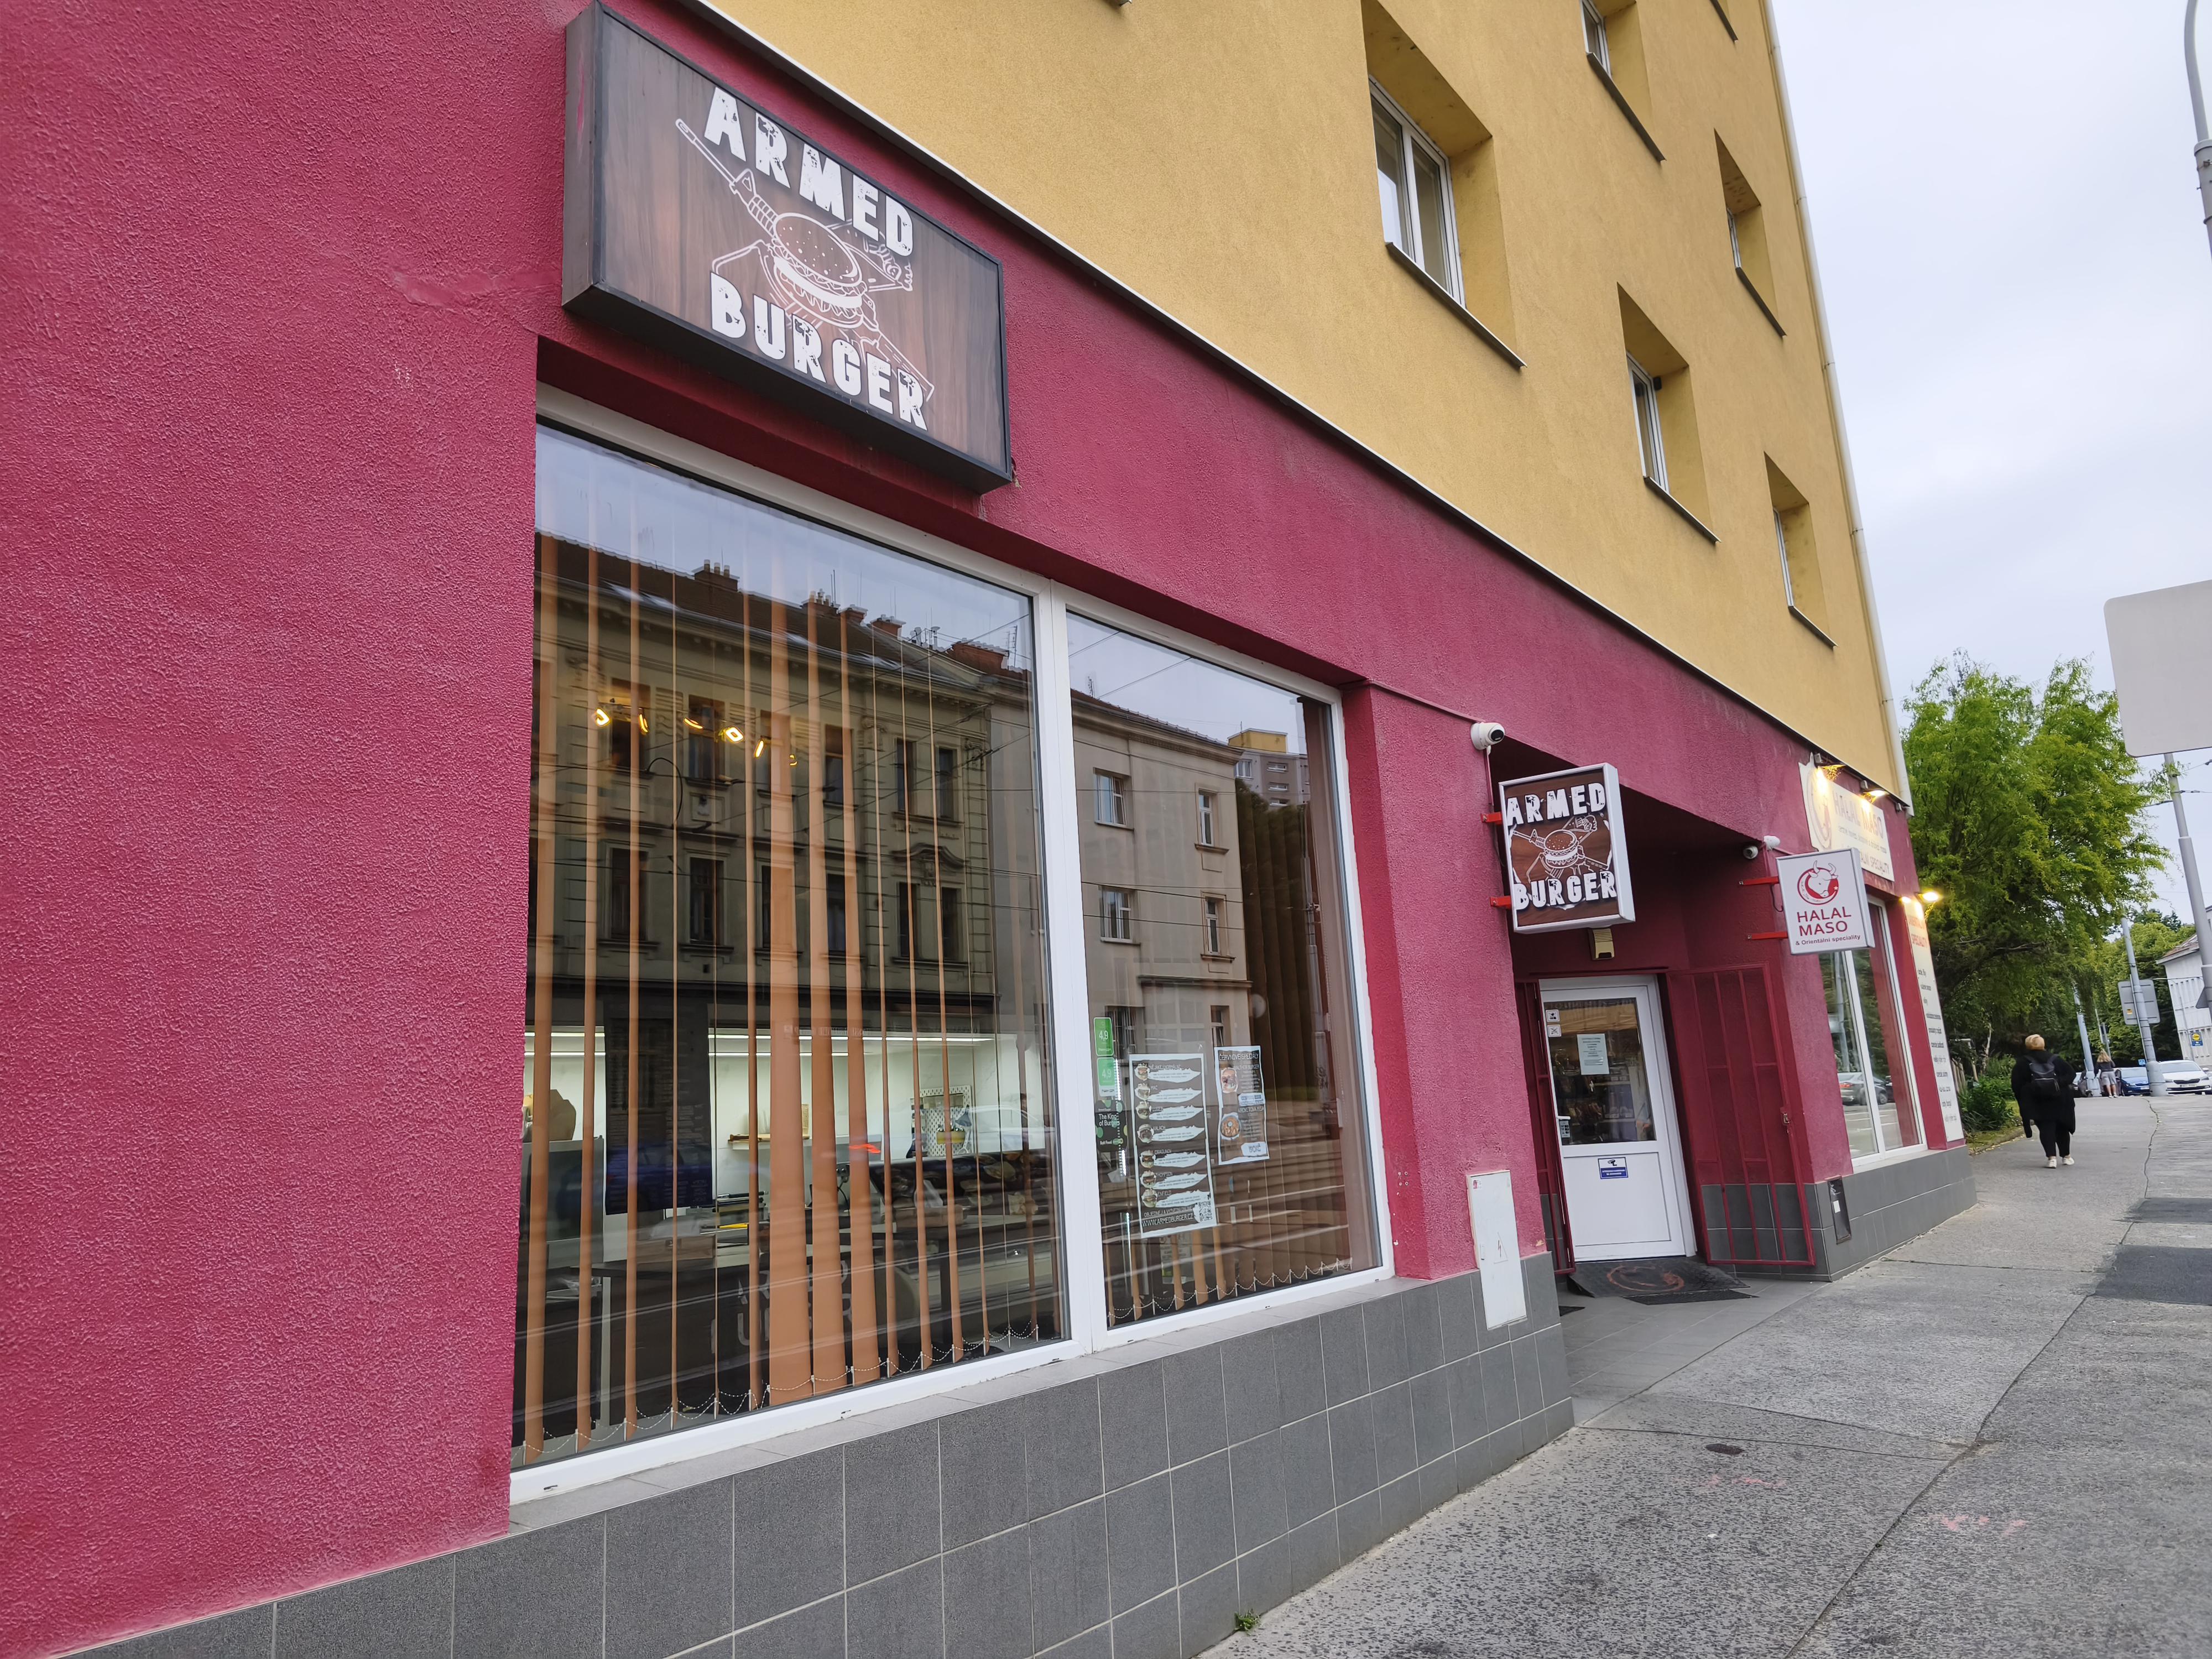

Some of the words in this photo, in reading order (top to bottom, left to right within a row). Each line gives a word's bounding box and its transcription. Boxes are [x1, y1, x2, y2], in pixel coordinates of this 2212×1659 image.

[704, 87, 914, 257] ARMED
[711, 272, 927, 431] BURGER
[1507, 783, 1605, 826] ARMED
[1833, 790, 1860, 827] HALAL
[1513, 871, 1617, 910] BURGER
[1797, 906, 1851, 923] HALAL
[1799, 921, 1848, 936] MASO
[1832, 934, 1861, 943] speciality
